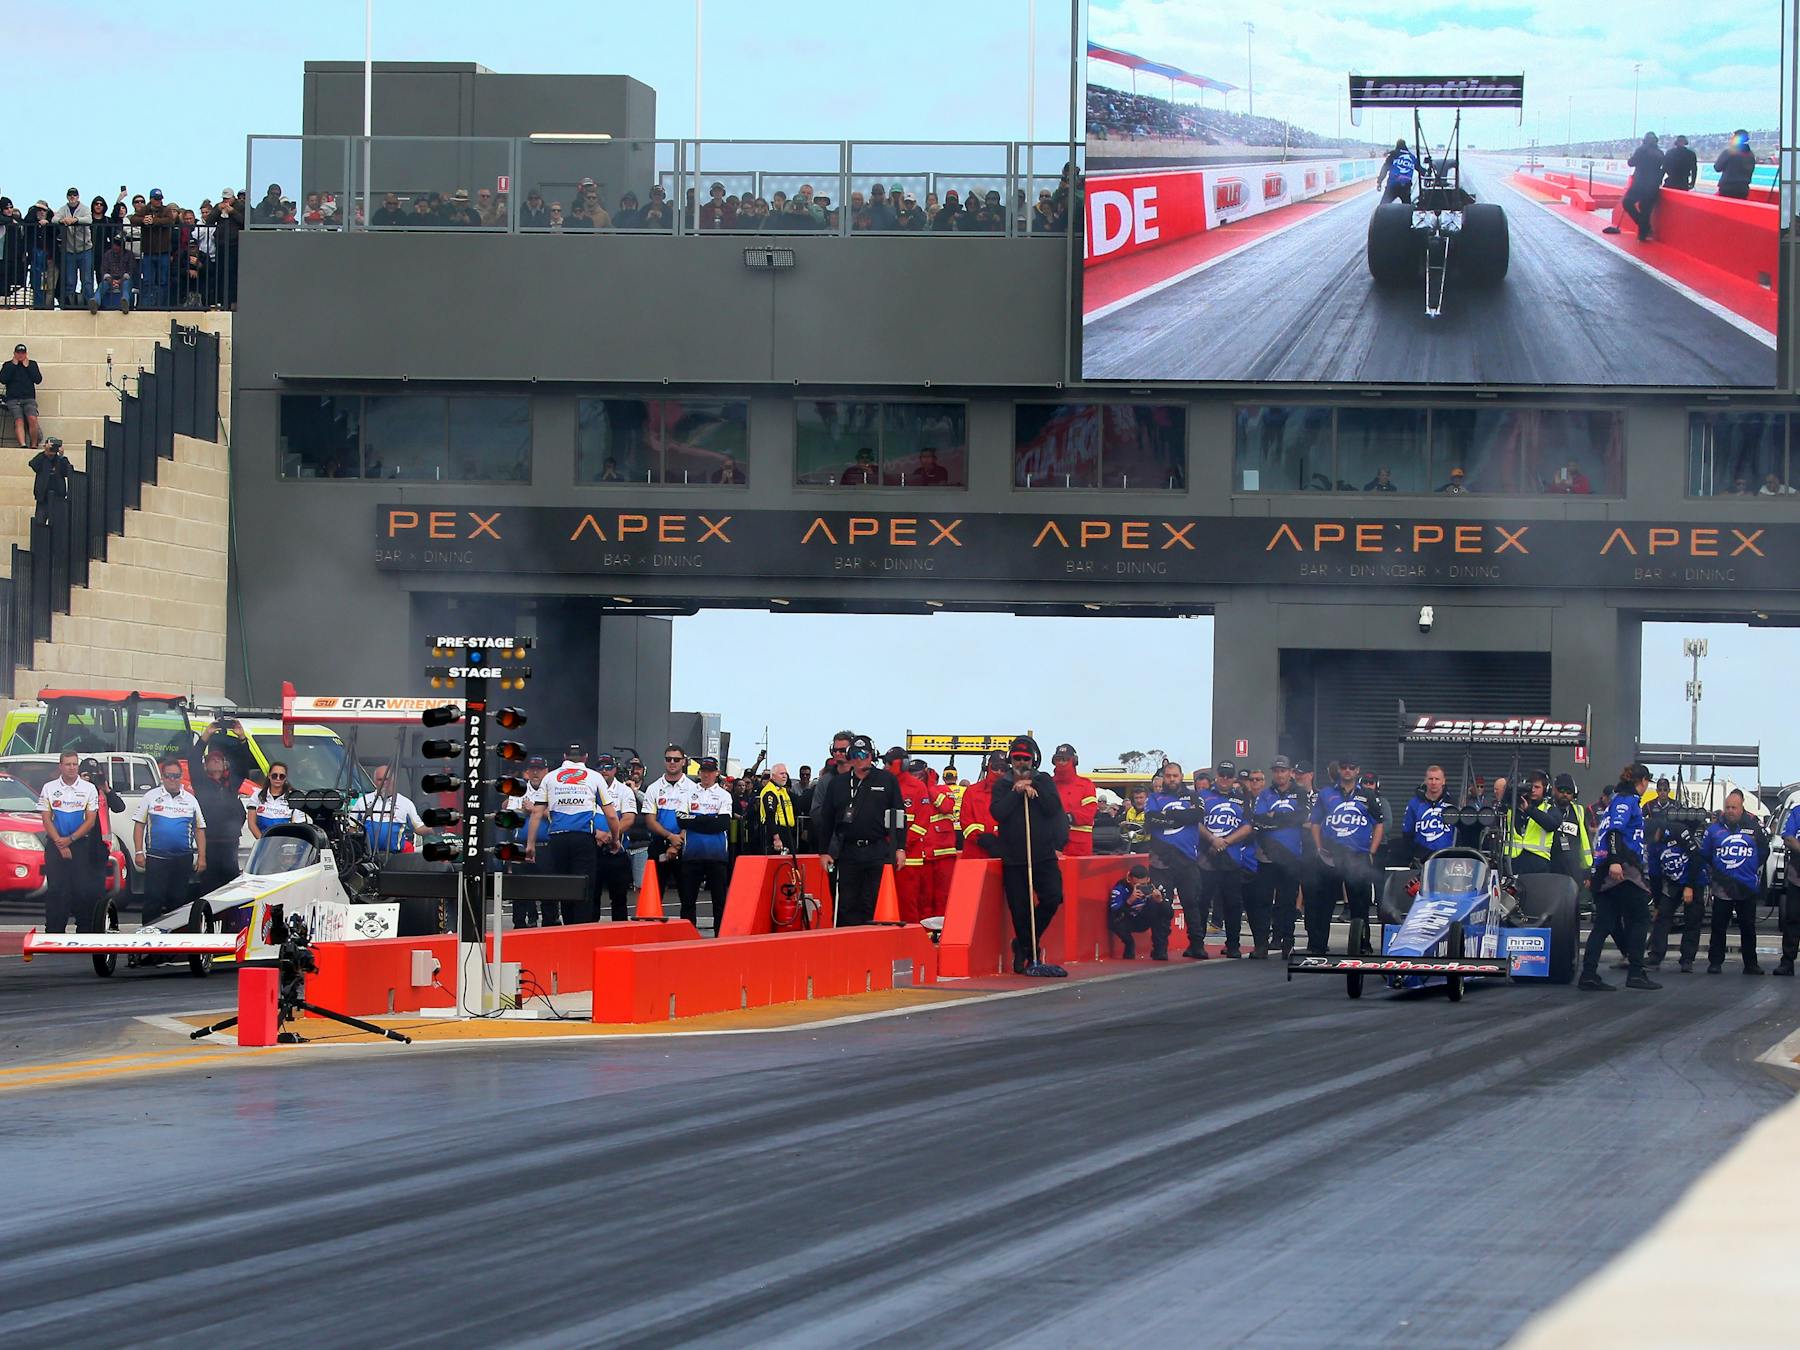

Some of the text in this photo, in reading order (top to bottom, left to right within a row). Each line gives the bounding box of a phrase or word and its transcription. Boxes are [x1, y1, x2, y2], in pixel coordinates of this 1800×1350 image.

[1362, 79, 1515, 98] Lamattina
[1084, 186, 1161, 260] DE
[569, 514, 733, 543] APEX
[800, 517, 963, 547] APEX
[1032, 520, 1197, 550] APEX
[1265, 523, 1402, 553] APE
[1599, 527, 1767, 557] APEX
[424, 551, 474, 564] DINING
[603, 553, 632, 566] BAR
[653, 554, 703, 568] DINING
[834, 557, 863, 569] BAR
[884, 558, 935, 570] DINING
[1066, 560, 1094, 573] BAR
[1116, 561, 1167, 574] DINING
[1300, 564, 1328, 576] BAR
[1450, 565, 1500, 578] DINING
[1634, 568, 1663, 580] BAR
[1685, 569, 1736, 582] DINING
[436, 637, 514, 648] PRE-STAGE
[448, 667, 502, 678] STAGE
[1413, 717, 1582, 736] Lamattina
[468, 715, 481, 789] DRAGWAY
[1204, 814, 1242, 828] FUCHS
[1326, 814, 1368, 827] FUCHS
[468, 815, 478, 857] BEND
[1716, 845, 1754, 858] FUCHS
